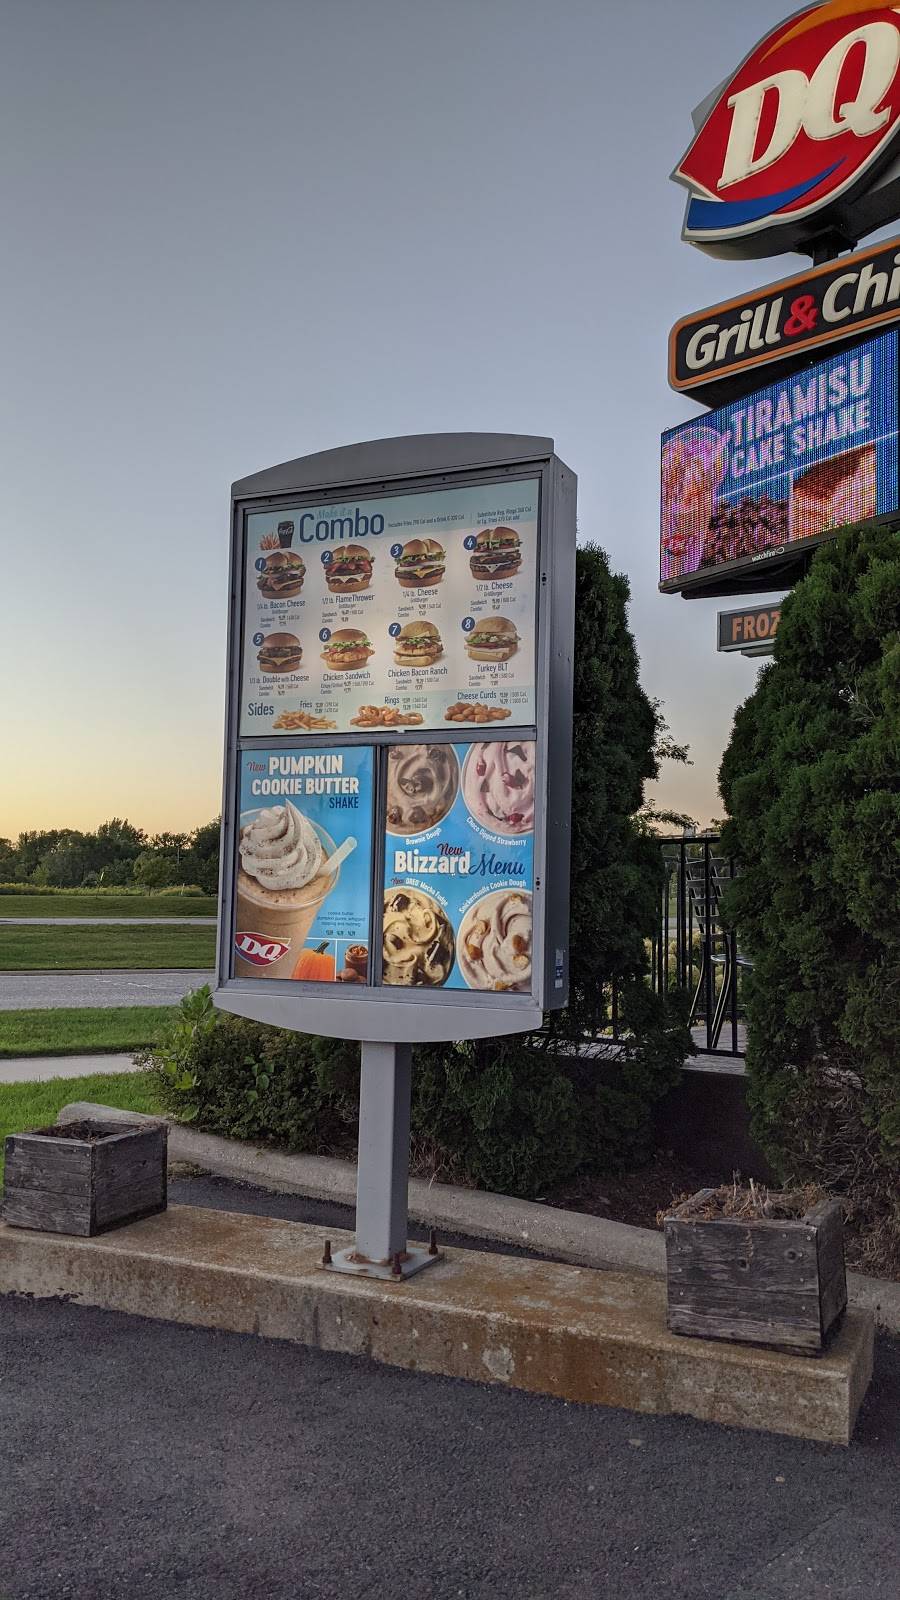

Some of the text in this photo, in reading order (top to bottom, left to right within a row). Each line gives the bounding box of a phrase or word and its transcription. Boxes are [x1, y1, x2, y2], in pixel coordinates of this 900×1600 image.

[716, 21, 900, 191] DQ
[731, 352, 872, 446] TIRAMISU
[731, 399, 871, 478] CAKE SHAKE
[300, 507, 384, 543] Combo
[418, 588, 438, 597] Cheese
[491, 582, 513, 590] Cheese
[270, 601, 286, 609] Bacon
[286, 600, 306, 608] Cheese
[388, 666, 448, 678] Chicken Bacon Ranch
[477, 662, 508, 673] Turkey BLT
[290, 674, 310, 682] Cheese
[323, 672, 371, 682] Chicken Sandwich
[384, 696, 400, 705] Rings
[457, 692, 479, 700] Cheese
[480, 690, 497, 699] Curds
[248, 702, 274, 716] Sides
[300, 700, 312, 708] Fries
[268, 754, 343, 776] PUMPKIN
[252, 777, 360, 796] COOKIE BUTTER
[329, 796, 359, 809] SHAKE
[405, 827, 443, 846] Brownie Dough
[466, 816, 527, 847] Choco Dipped Strawberry
[436, 843, 464, 856] New
[394, 848, 526, 876] Blizzard Menu
[490, 880, 509, 890] Cookie
[508, 879, 527, 887] Dough
[420, 882, 436, 895] Mocha
[434, 891, 449, 907] Fudge
[240, 935, 282, 962] DQ
